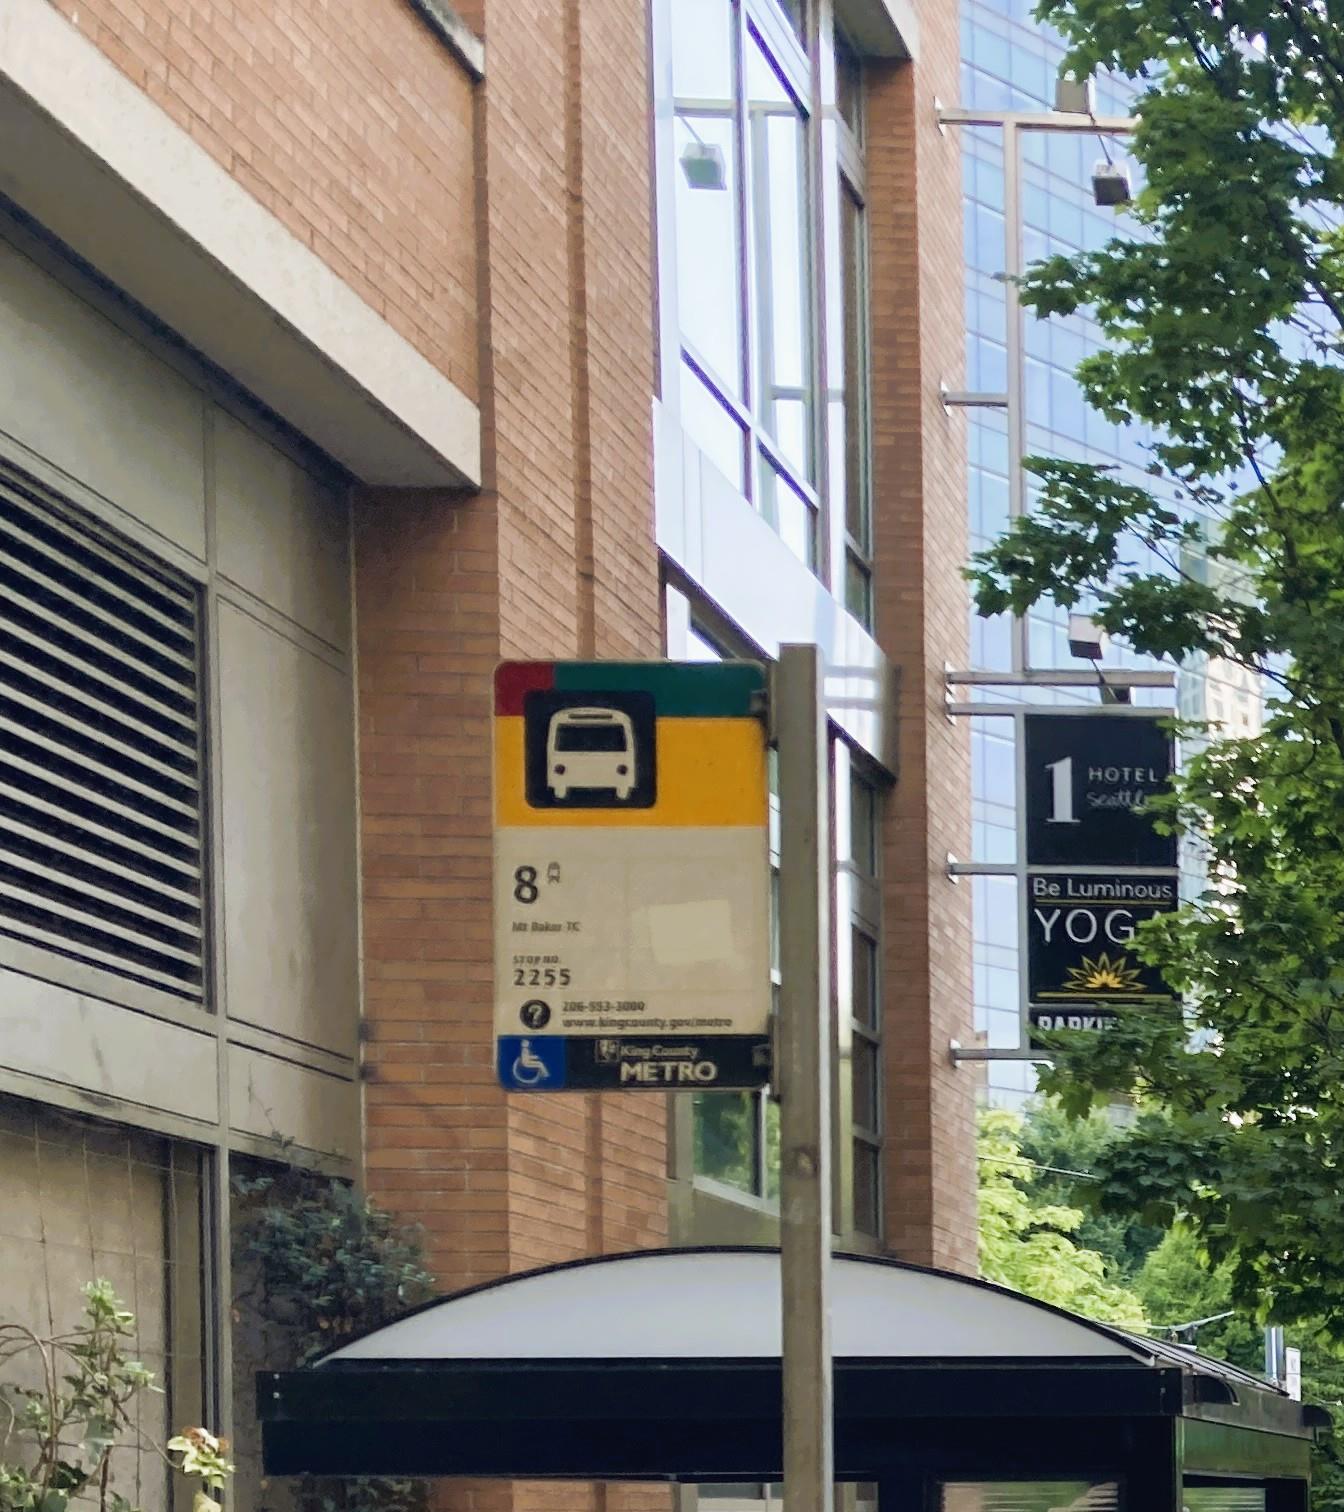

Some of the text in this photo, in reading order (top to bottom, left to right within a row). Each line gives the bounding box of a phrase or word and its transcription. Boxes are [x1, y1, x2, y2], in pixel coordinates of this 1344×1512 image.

[1088, 767, 1158, 782] HOTEL
[1044, 756, 1081, 823] 1
[514, 865, 538, 904] 8
[1033, 878, 1173, 898] Be Luminous
[1034, 908, 1160, 944] YOG
[513, 968, 571, 986] 2255
[621, 1045, 699, 1059] King County
[620, 1061, 718, 1081] METRO
